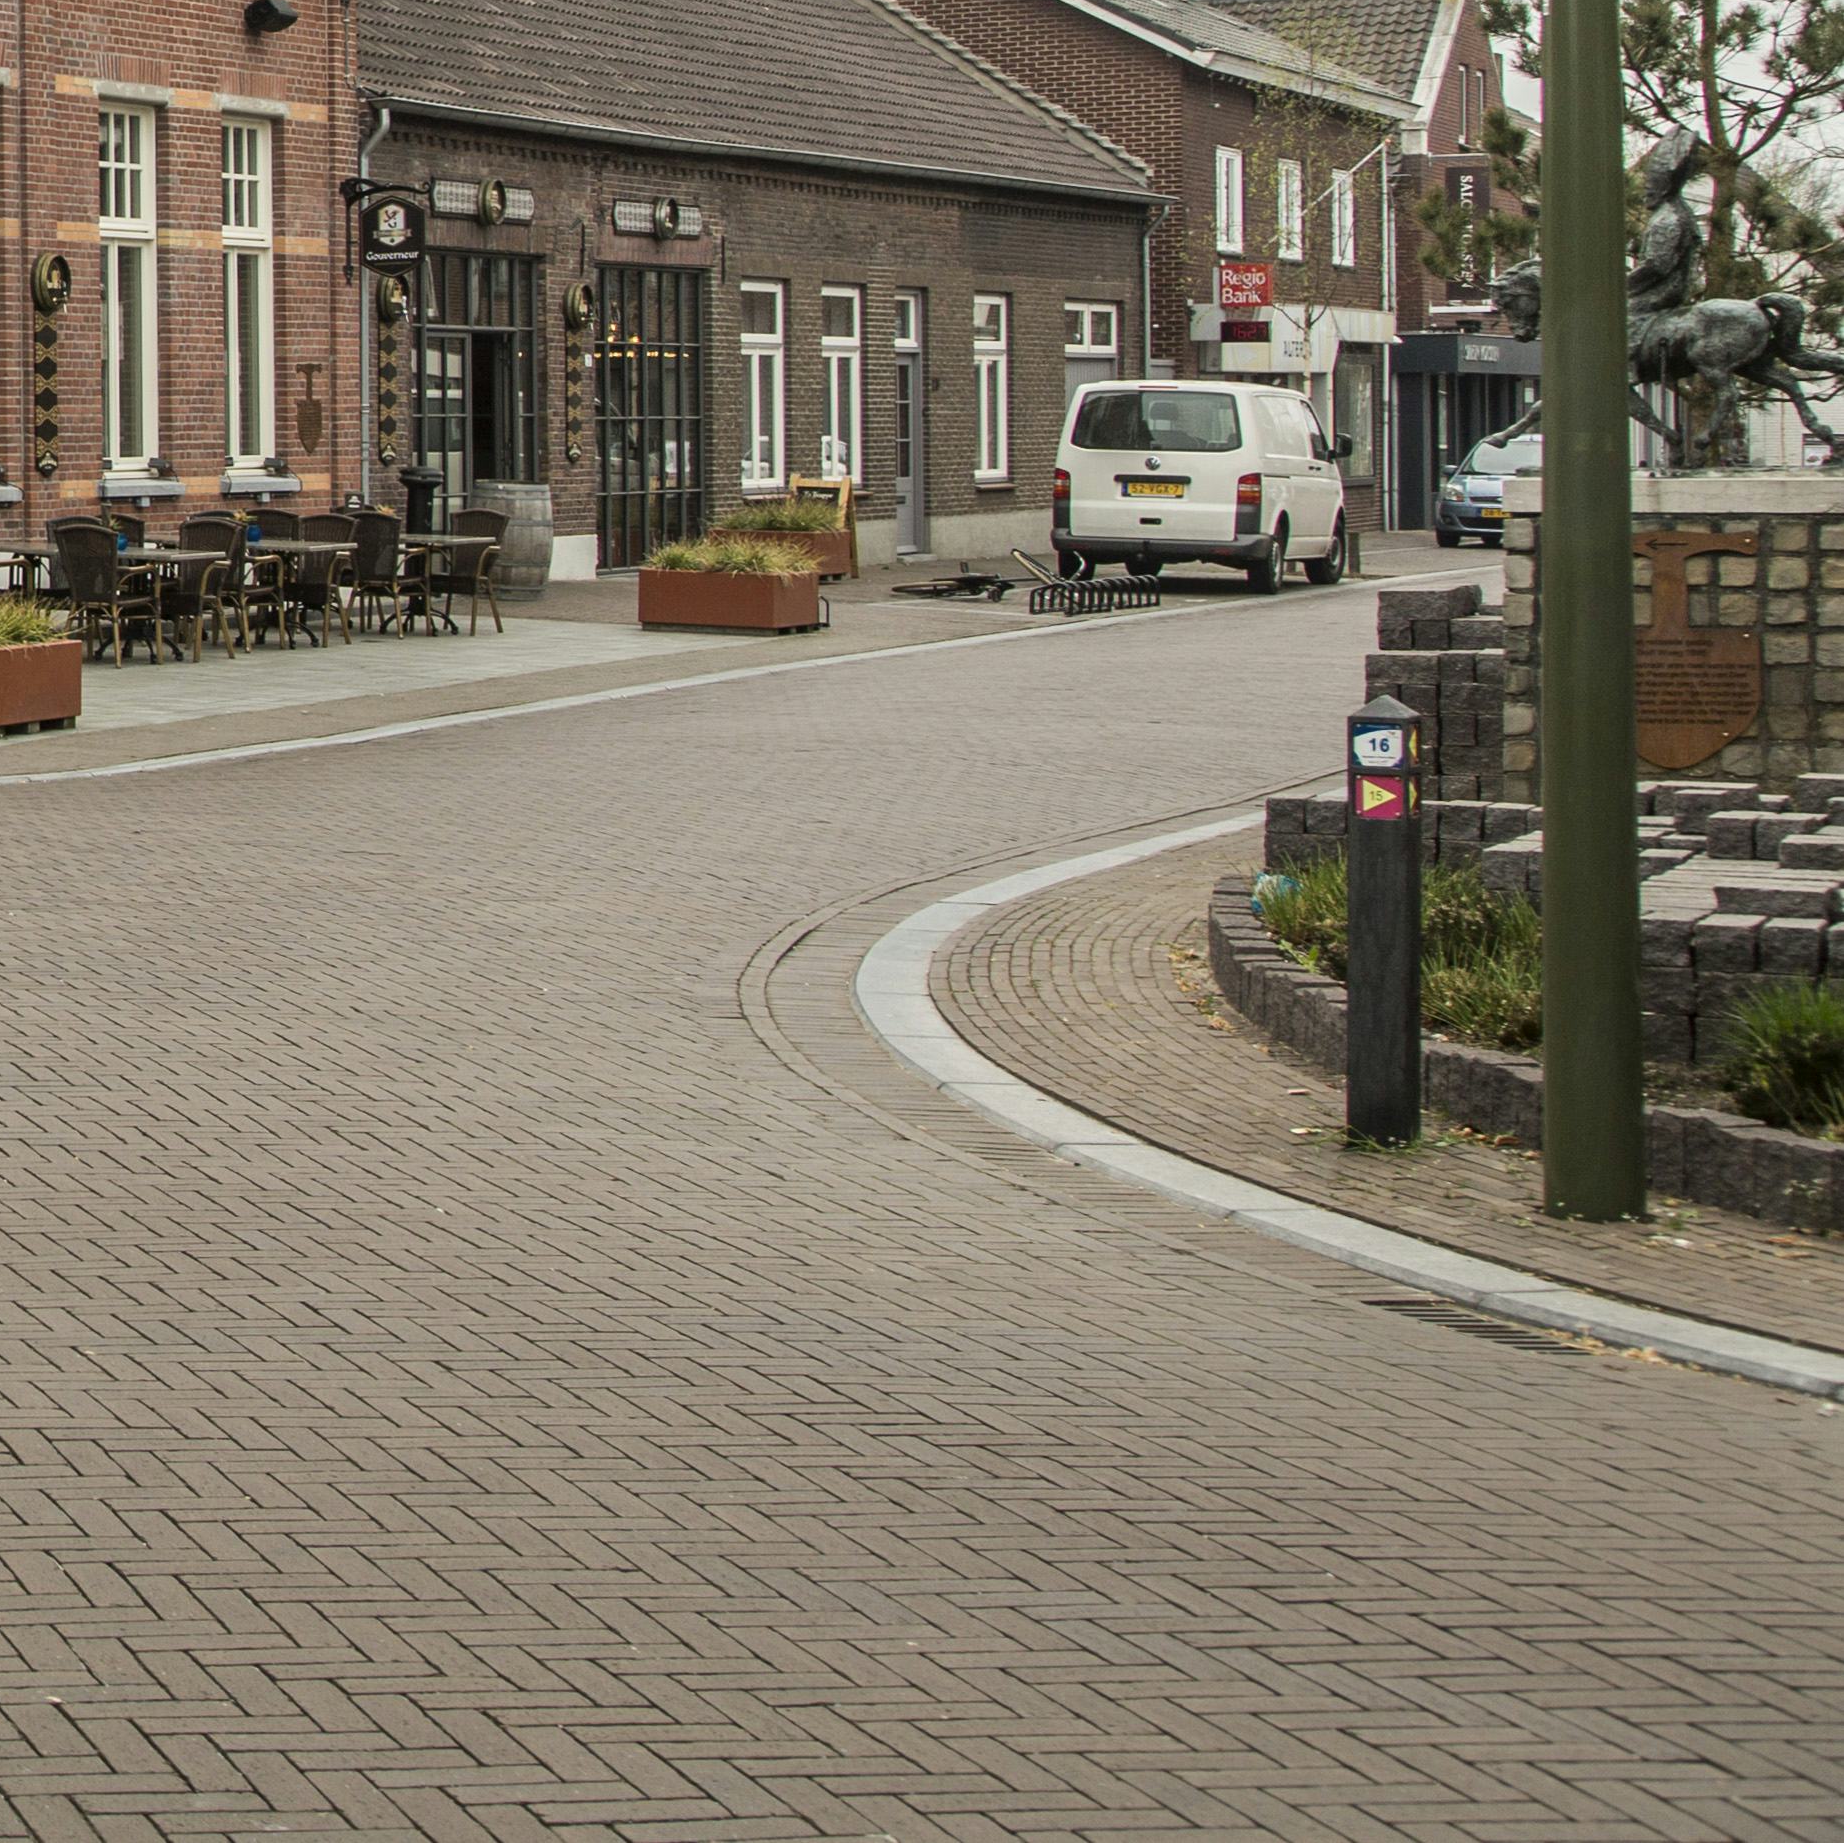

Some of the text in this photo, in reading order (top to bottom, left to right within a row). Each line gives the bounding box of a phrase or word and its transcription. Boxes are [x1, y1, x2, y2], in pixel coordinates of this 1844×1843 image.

[366, 251, 419, 261] Gouverneur
[1221, 268, 1266, 289] Regio
[1221, 288, 1262, 304] Bank
[1369, 738, 1390, 753] 16
[1369, 790, 1383, 802] 15
